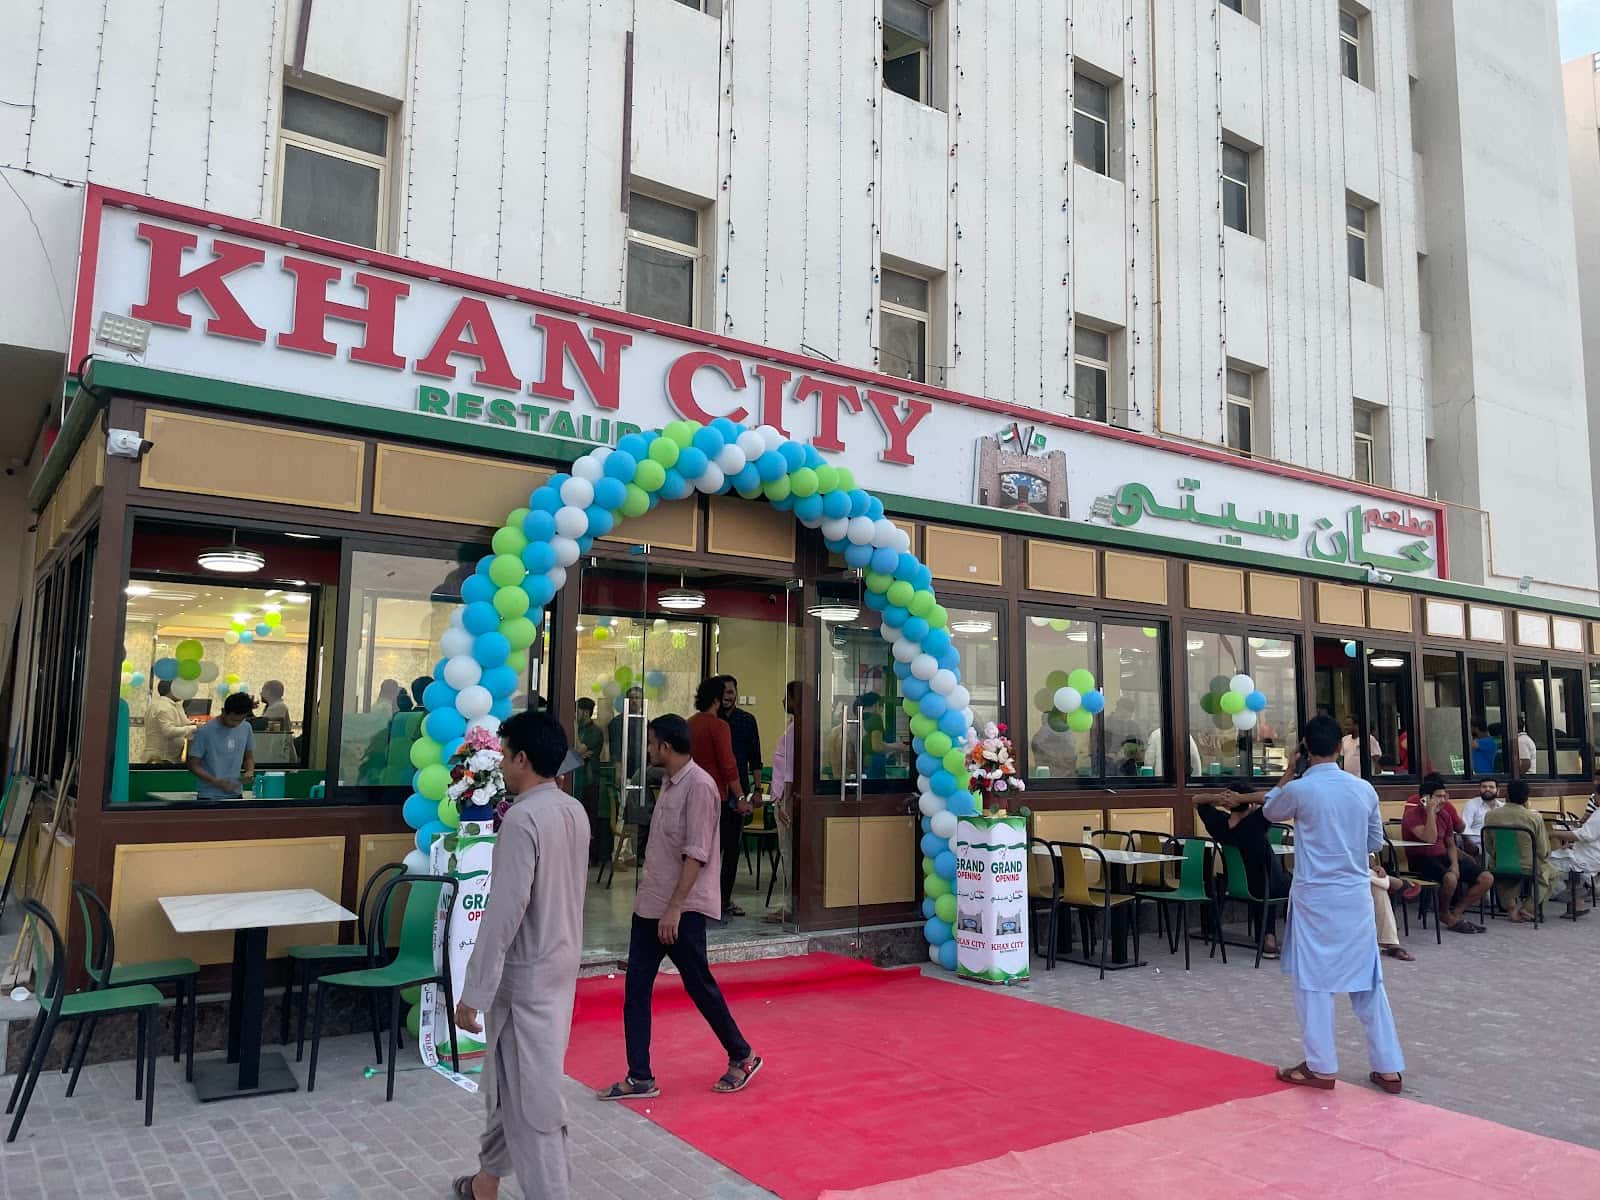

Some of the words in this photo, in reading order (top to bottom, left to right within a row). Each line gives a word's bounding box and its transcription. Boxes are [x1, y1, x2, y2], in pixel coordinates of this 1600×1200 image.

[131, 223, 632, 410] KHAN
[666, 351, 933, 465] CITY
[418, 384, 663, 446] RESTAUR
[1364, 507, 1434, 537] مطعم
[1306, 504, 1435, 571] خان
[991, 861, 1023, 874] GRAND
[957, 871, 982, 881] OPENING
[995, 873, 1020, 883] OPENING
[971, 939, 986, 949] CITY
[1010, 940, 1024, 949] CITY
